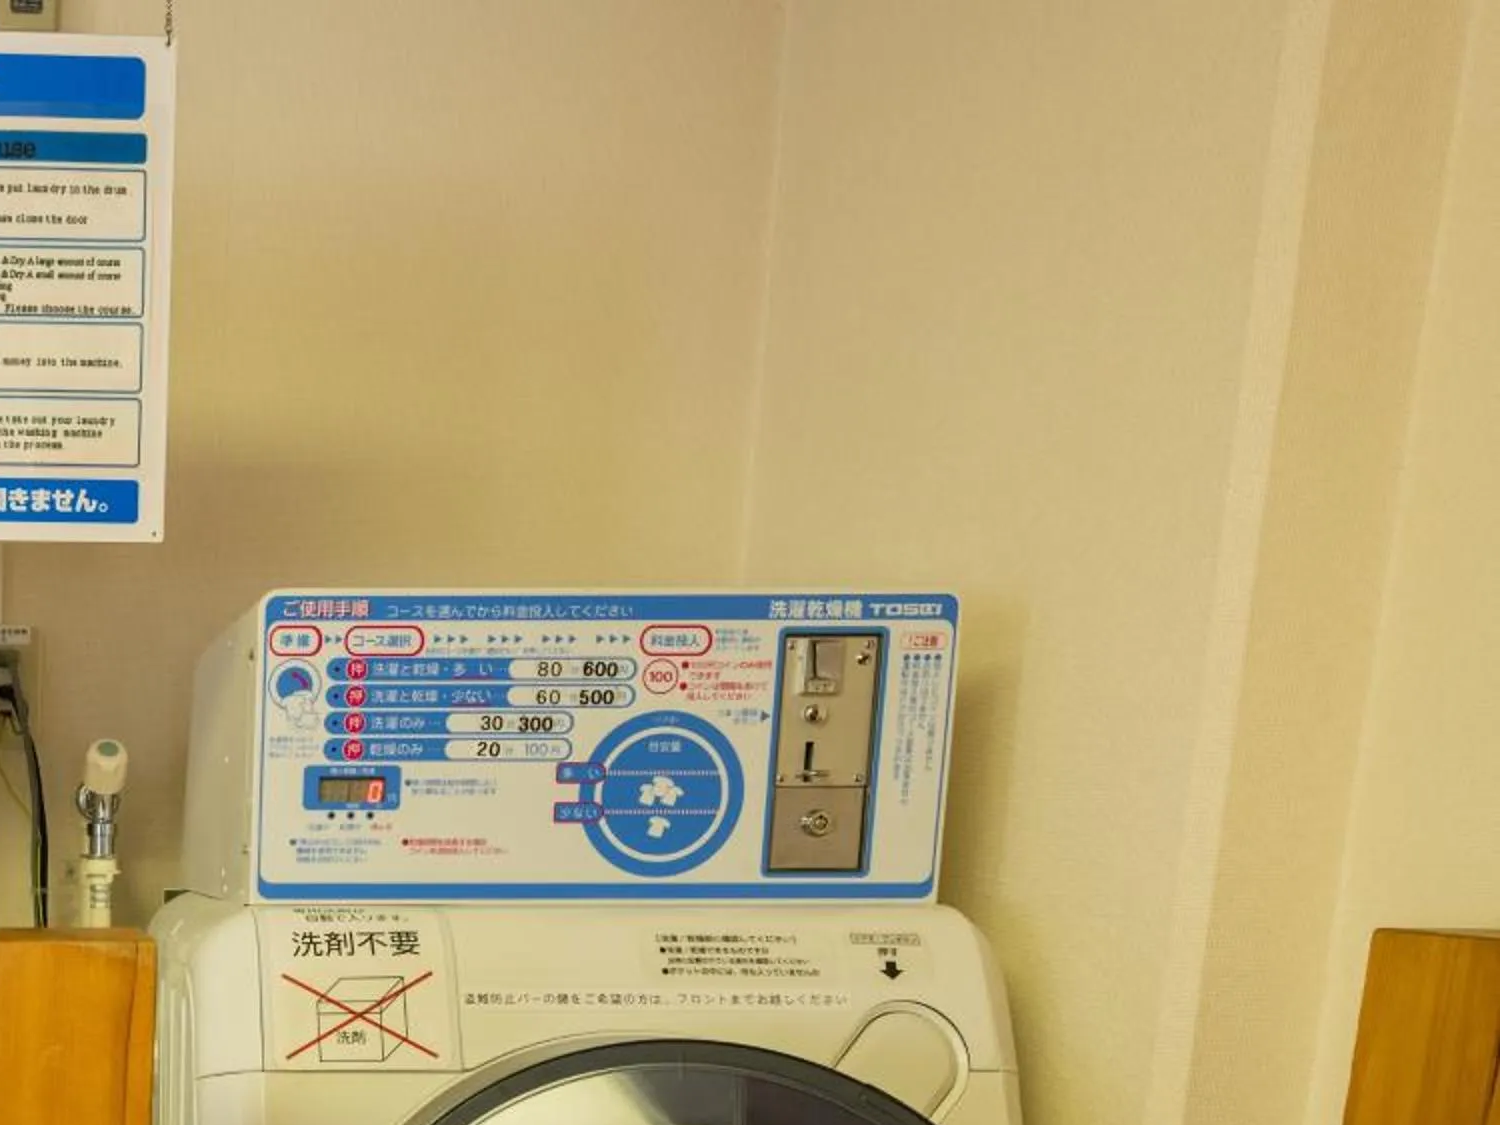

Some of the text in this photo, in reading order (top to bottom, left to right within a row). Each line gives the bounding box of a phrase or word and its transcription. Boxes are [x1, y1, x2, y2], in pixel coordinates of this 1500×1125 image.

[83, 184, 100, 195] the
[15, 212, 43, 224] close
[45, 213, 62, 224] the
[4, 303, 39, 314] Please
[283, 599, 369, 618] ご使用手順
[536, 661, 563, 677] 80
[582, 661, 619, 677] 600
[649, 669, 673, 683] 100
[535, 689, 561, 705] 60
[578, 689, 615, 705] 500
[480, 715, 504, 731] 30
[518, 716, 553, 732] 300
[476, 741, 501, 757] 20
[367, 779, 384, 803] 0
[292, 930, 421, 957] 洗剤不要
[336, 1030, 368, 1046] 洗剤
